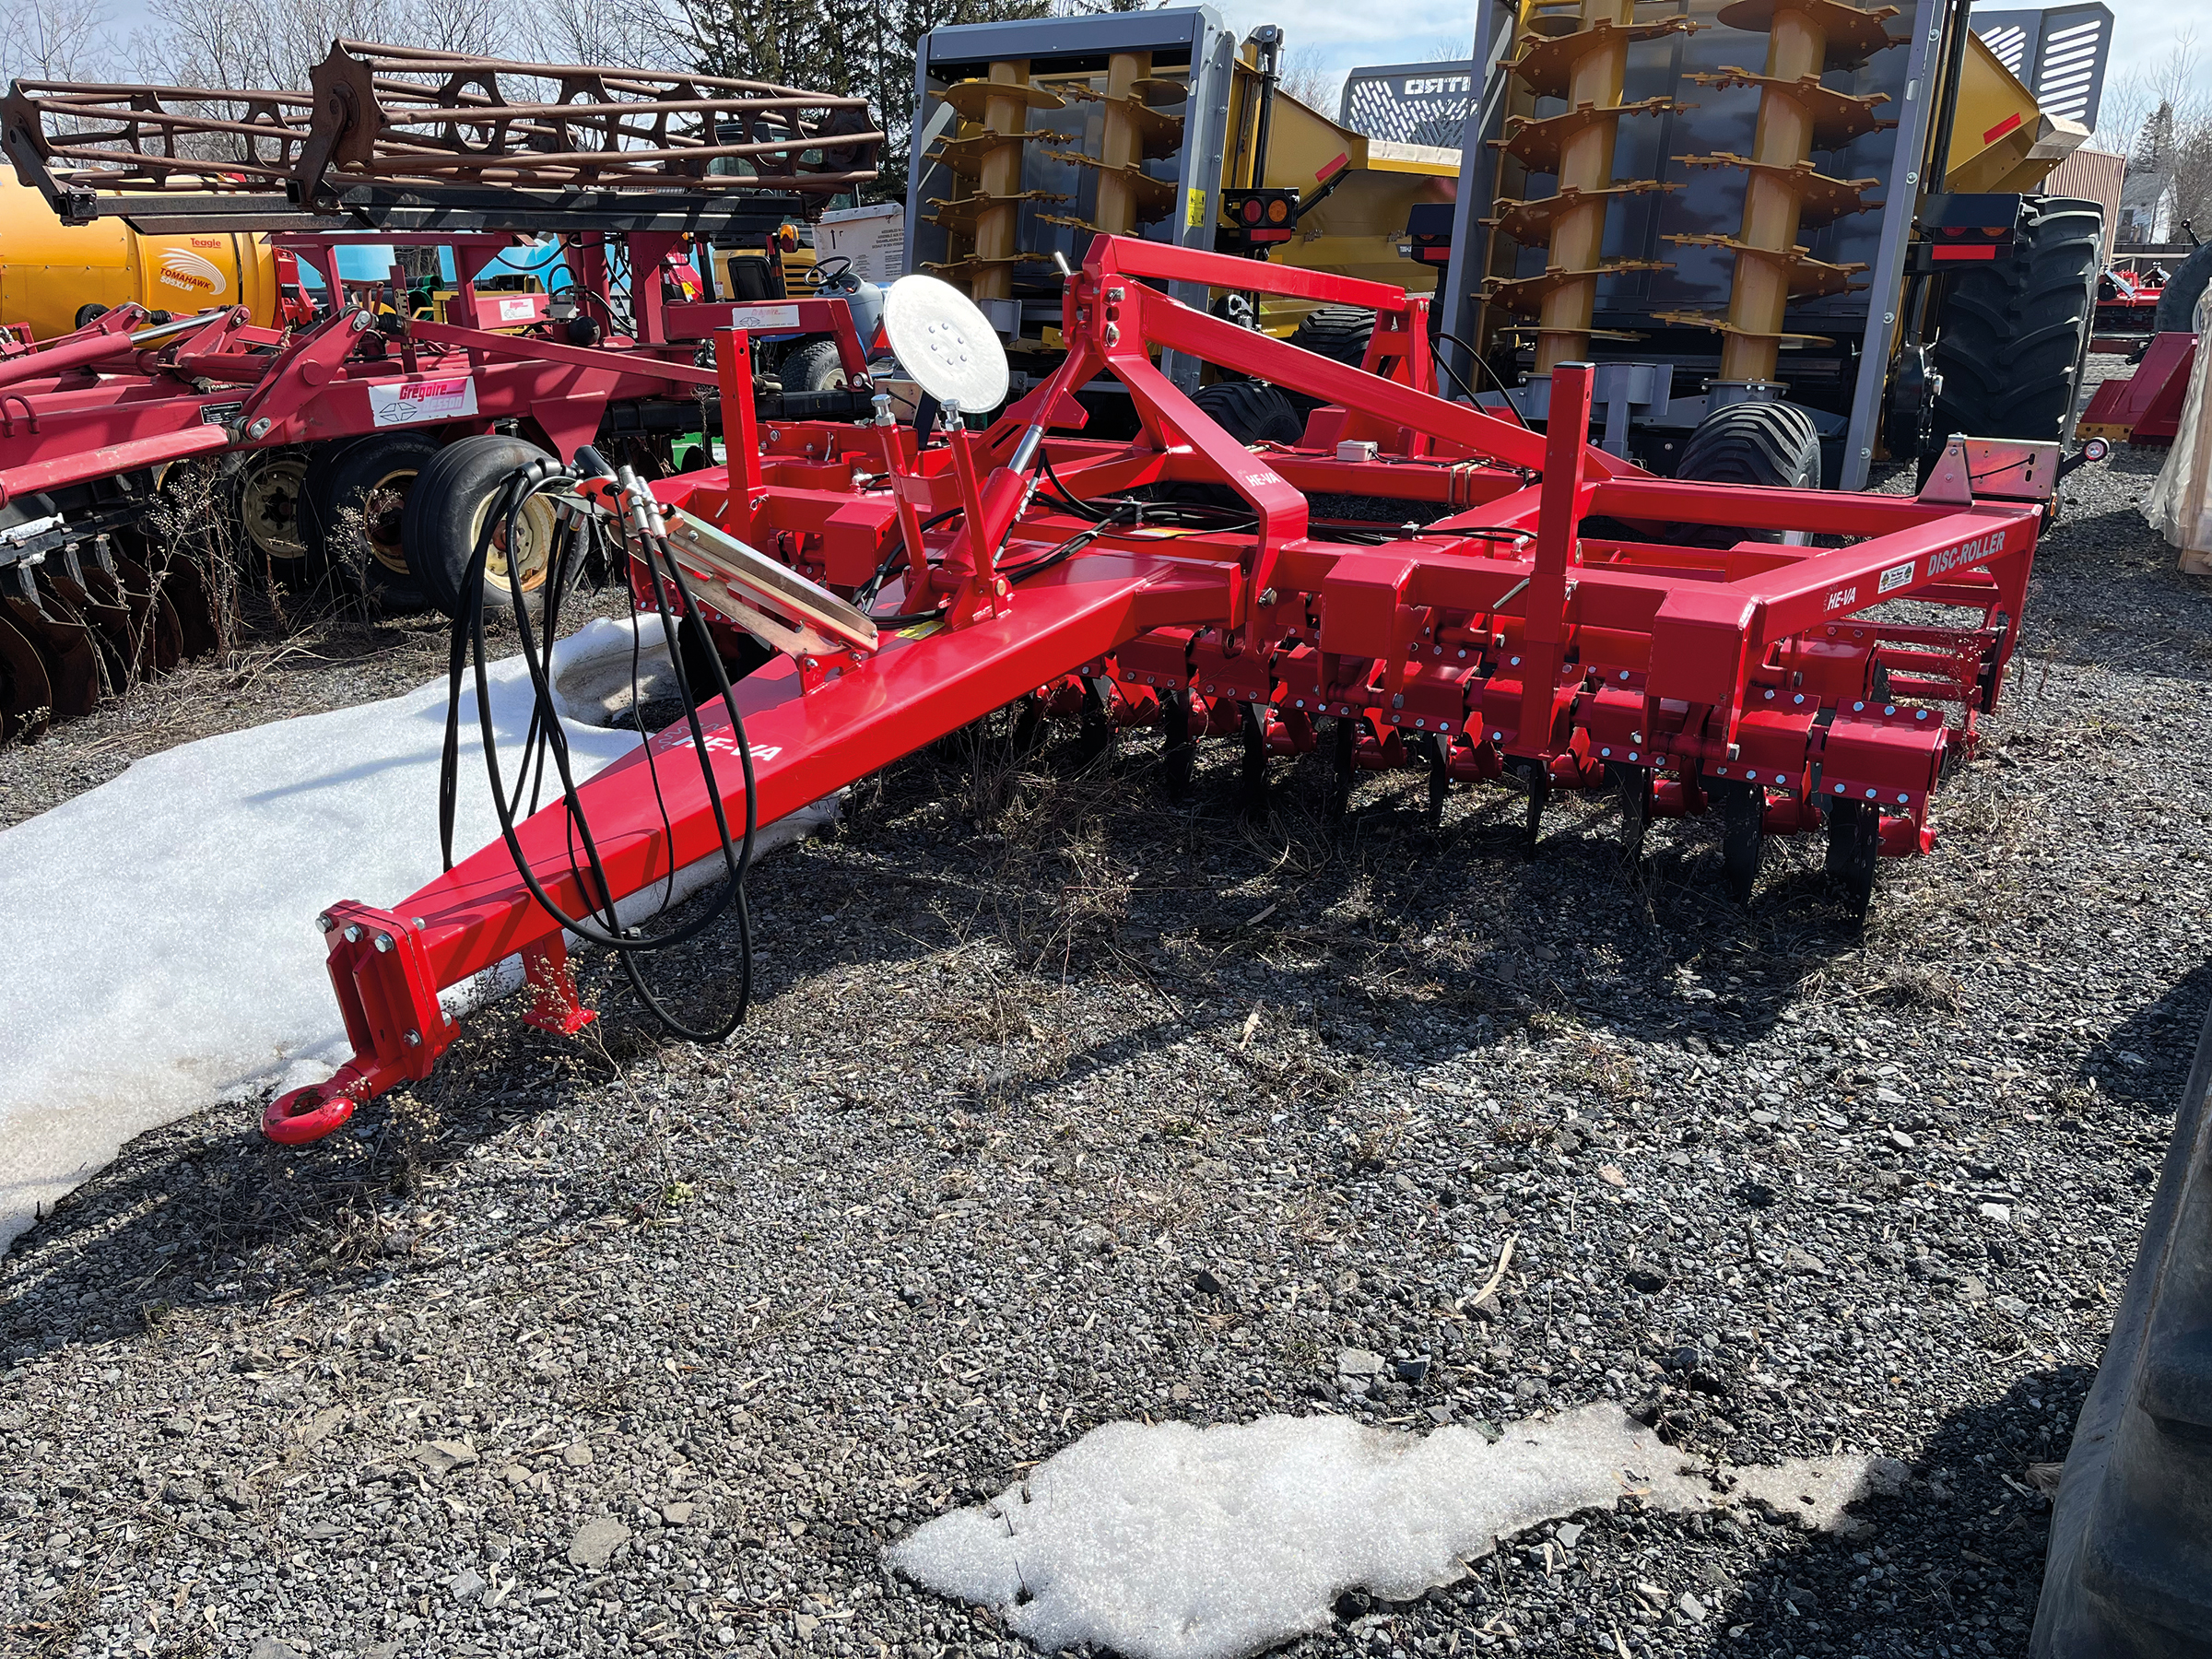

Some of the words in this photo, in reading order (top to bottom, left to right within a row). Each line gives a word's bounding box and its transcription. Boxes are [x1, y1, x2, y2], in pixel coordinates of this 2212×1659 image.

[190, 238, 221, 249] Teagle
[160, 267, 211, 289] TOMAHAWK
[160, 276, 194, 292] 505XLM
[399, 383, 448, 402] Grégoire
[1245, 472, 1281, 487] HE-VA
[1926, 531, 2006, 578] DISC-ROLLER
[1827, 586, 1856, 611] HE-VA
